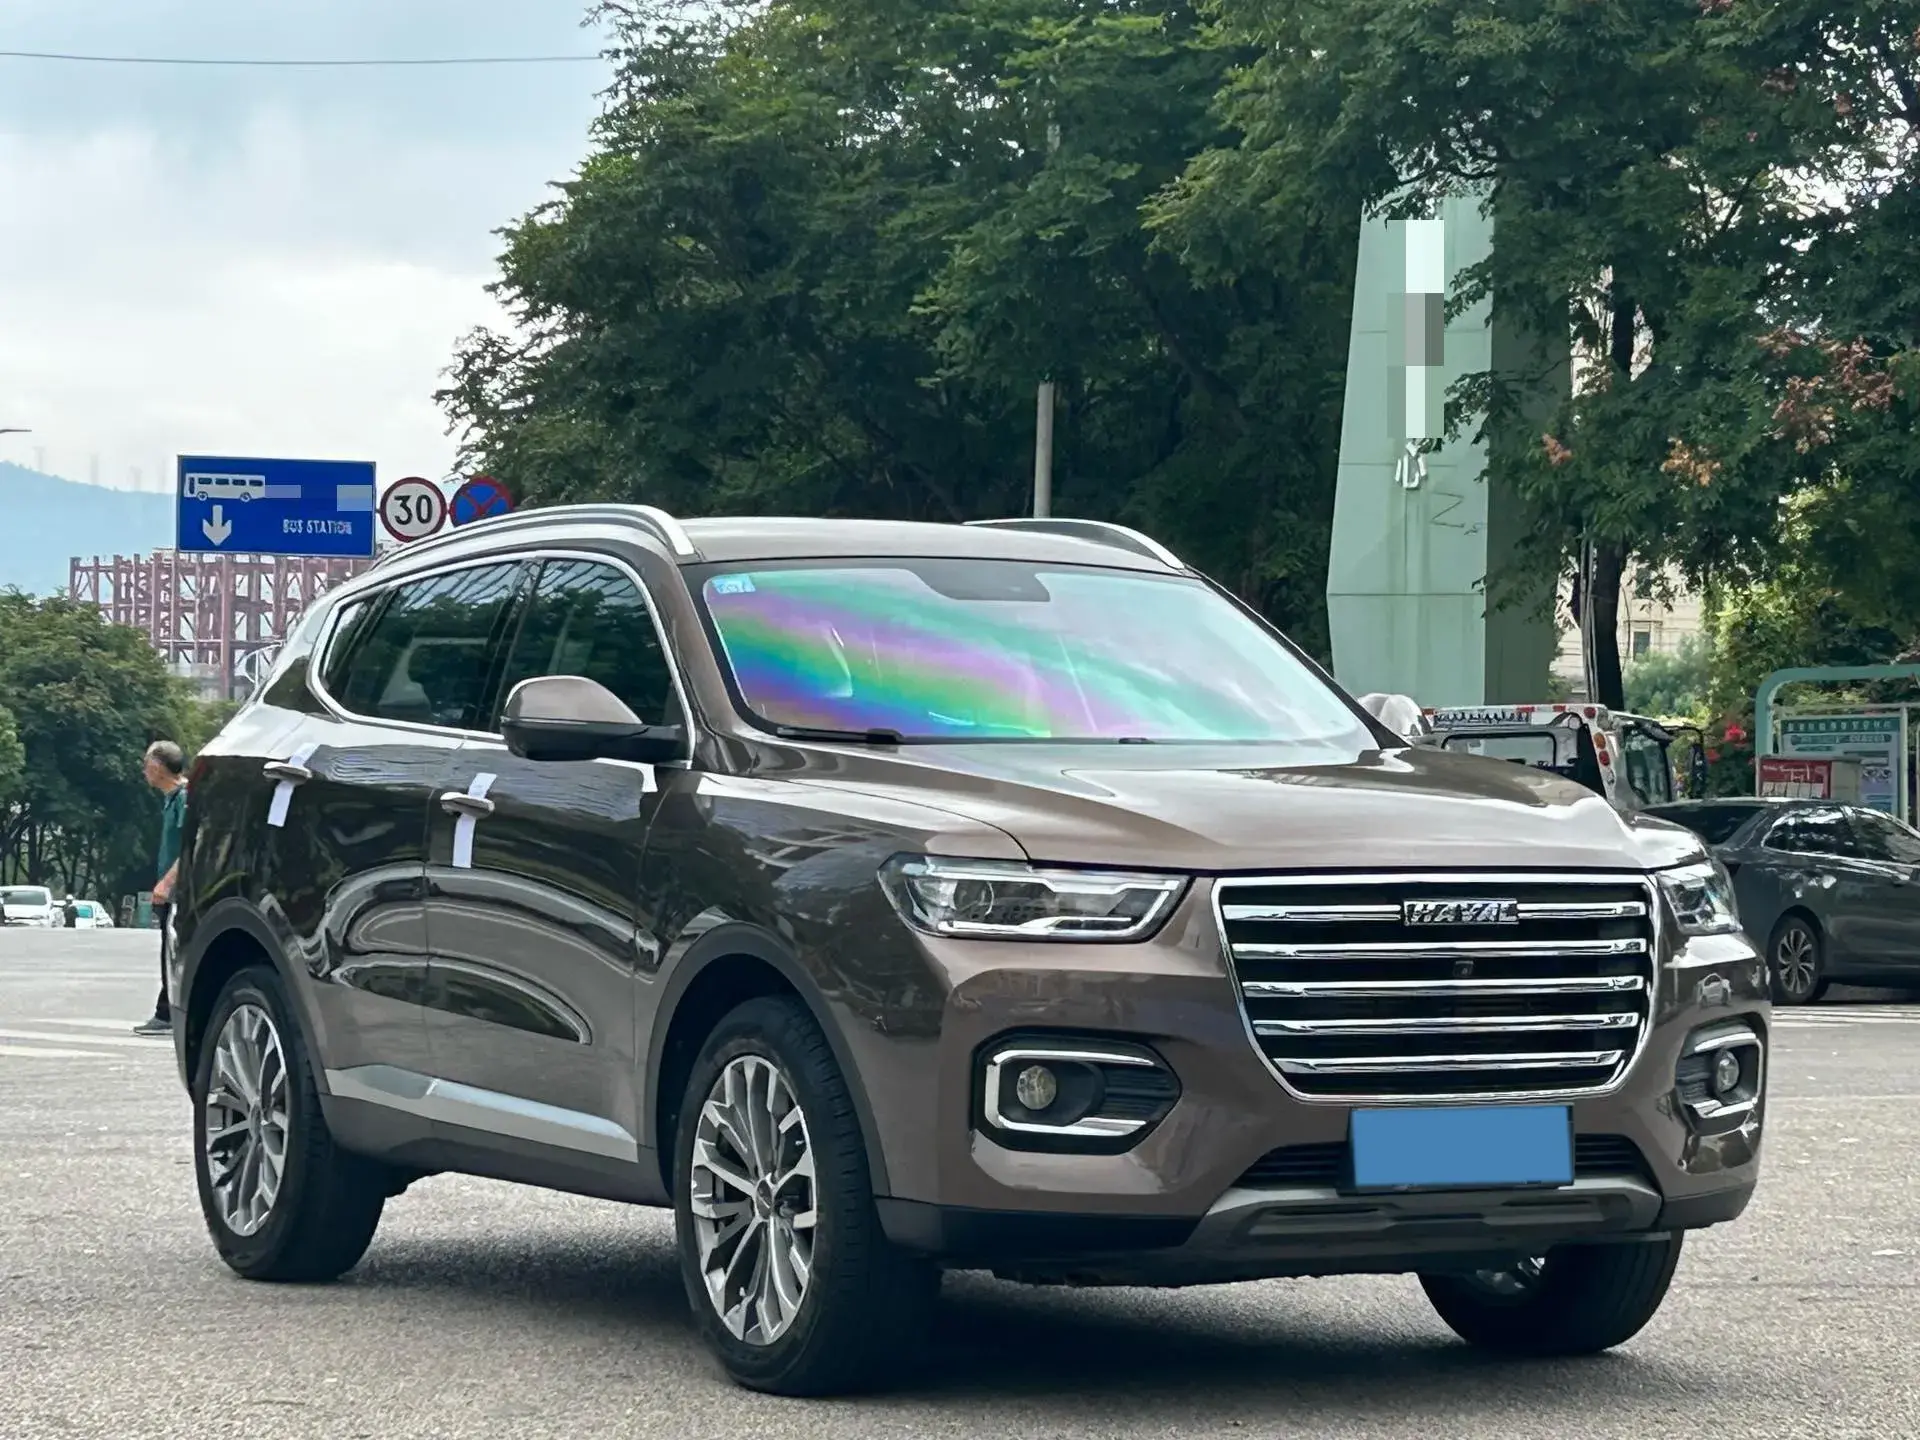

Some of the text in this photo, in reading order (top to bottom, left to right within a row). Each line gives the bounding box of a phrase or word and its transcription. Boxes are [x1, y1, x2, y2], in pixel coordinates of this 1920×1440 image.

[394, 494, 433, 525] 30
[282, 519, 352, 535] BUS STATION
[1404, 900, 1519, 924] HAVAL
